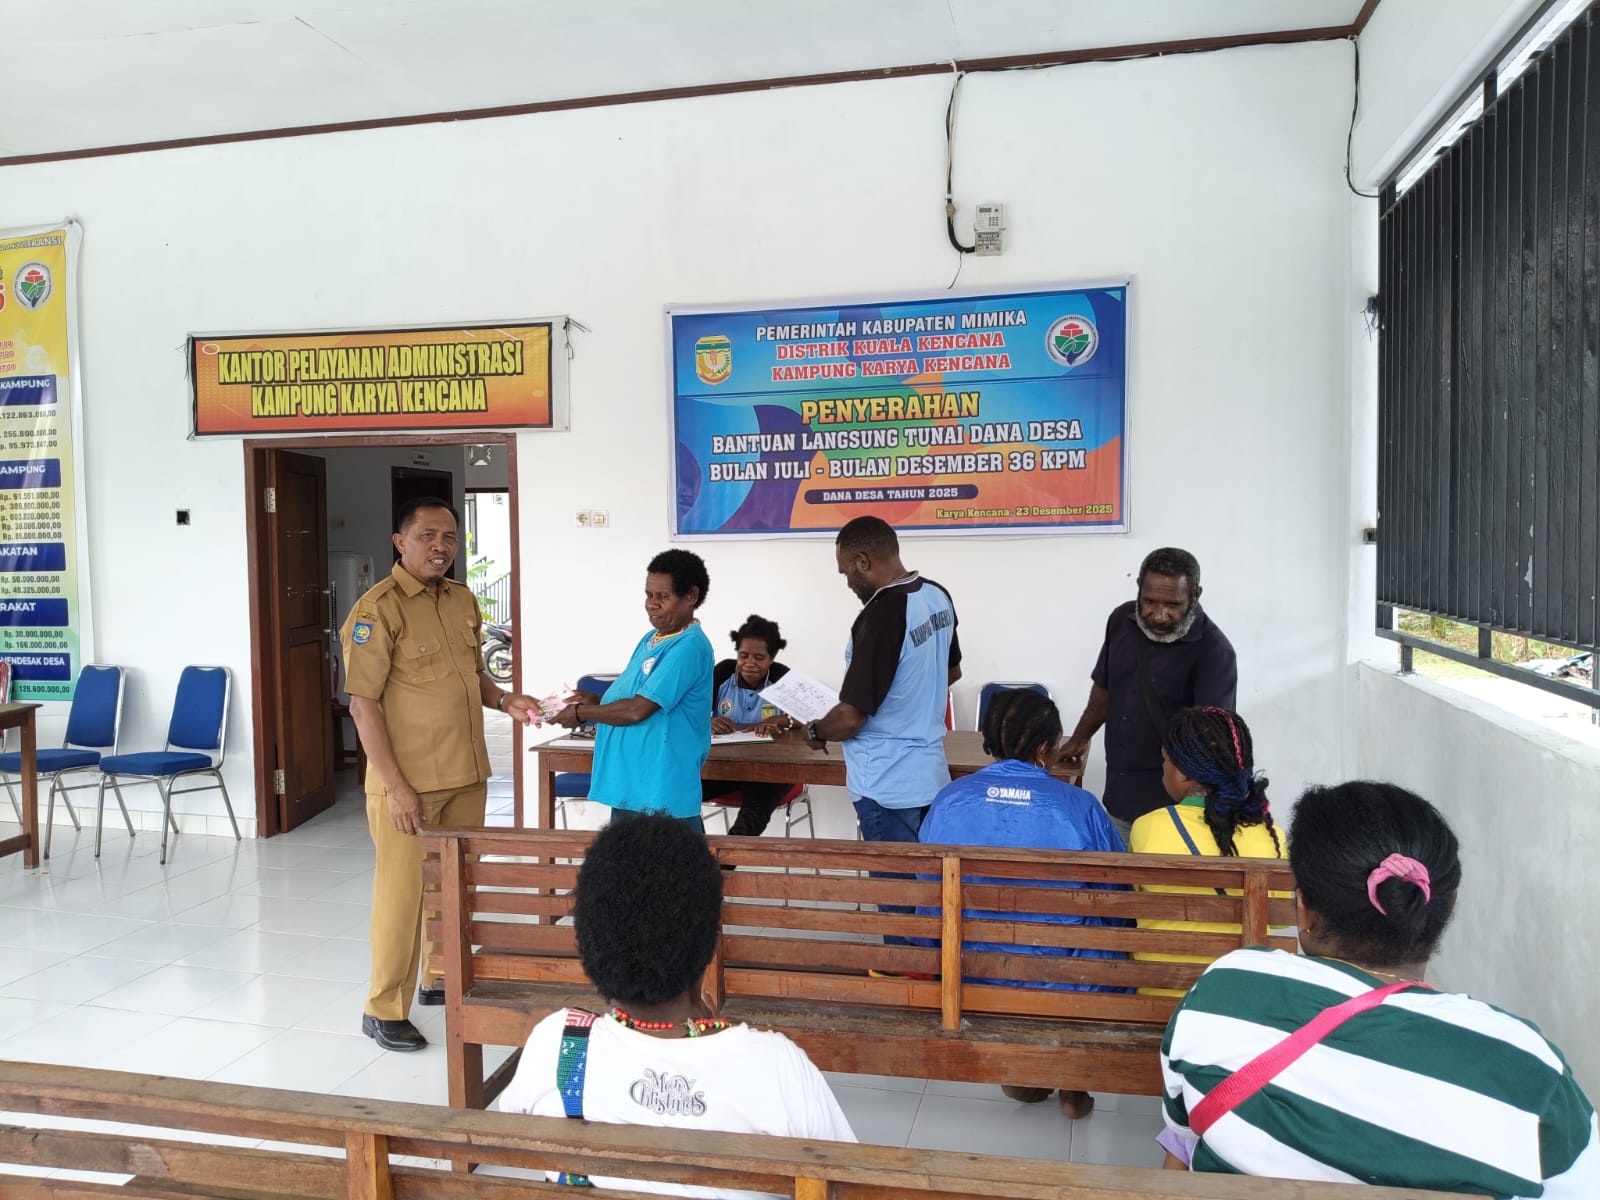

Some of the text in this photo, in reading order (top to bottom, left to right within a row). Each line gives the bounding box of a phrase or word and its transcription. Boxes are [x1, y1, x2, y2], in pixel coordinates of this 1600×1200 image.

[756, 309, 1027, 342] PEMERINTAH KABUPATEN MIMIKA
[776, 331, 1006, 360] DISTRIK KUALA KENCANA
[218, 340, 524, 385] KANTOR PELAYANAN ADMINISTRASI
[771, 354, 1012, 382] KAMPUNG KARYA KENCANA
[252, 379, 488, 418] KAMPUNG KARYA KENCANA
[801, 391, 980, 425] PENYERAHAN
[713, 418, 1083, 454] BANTUAN LANGSUNG TUNAI DANA DESA
[710, 461, 768, 481] BULAN
[774, 460, 811, 479] JULI
[829, 456, 890, 478] BULAN
[896, 452, 1003, 475] DESEMBER
[1009, 450, 1036, 471] 36
[1041, 449, 1086, 470] KPM
[823, 487, 958, 501] DANA DESA TAHUN 2025
[936, 508, 965, 520] Karya
[1015, 506, 1029, 516] 23
[1032, 505, 1083, 516] Desember
[1085, 504, 1113, 515] 2025
[43, 656, 65, 666] DESA
[1000, 787, 1031, 800] YAMAHA
[643, 1067, 697, 1093] Merry
[629, 1079, 707, 1117] Christmas
